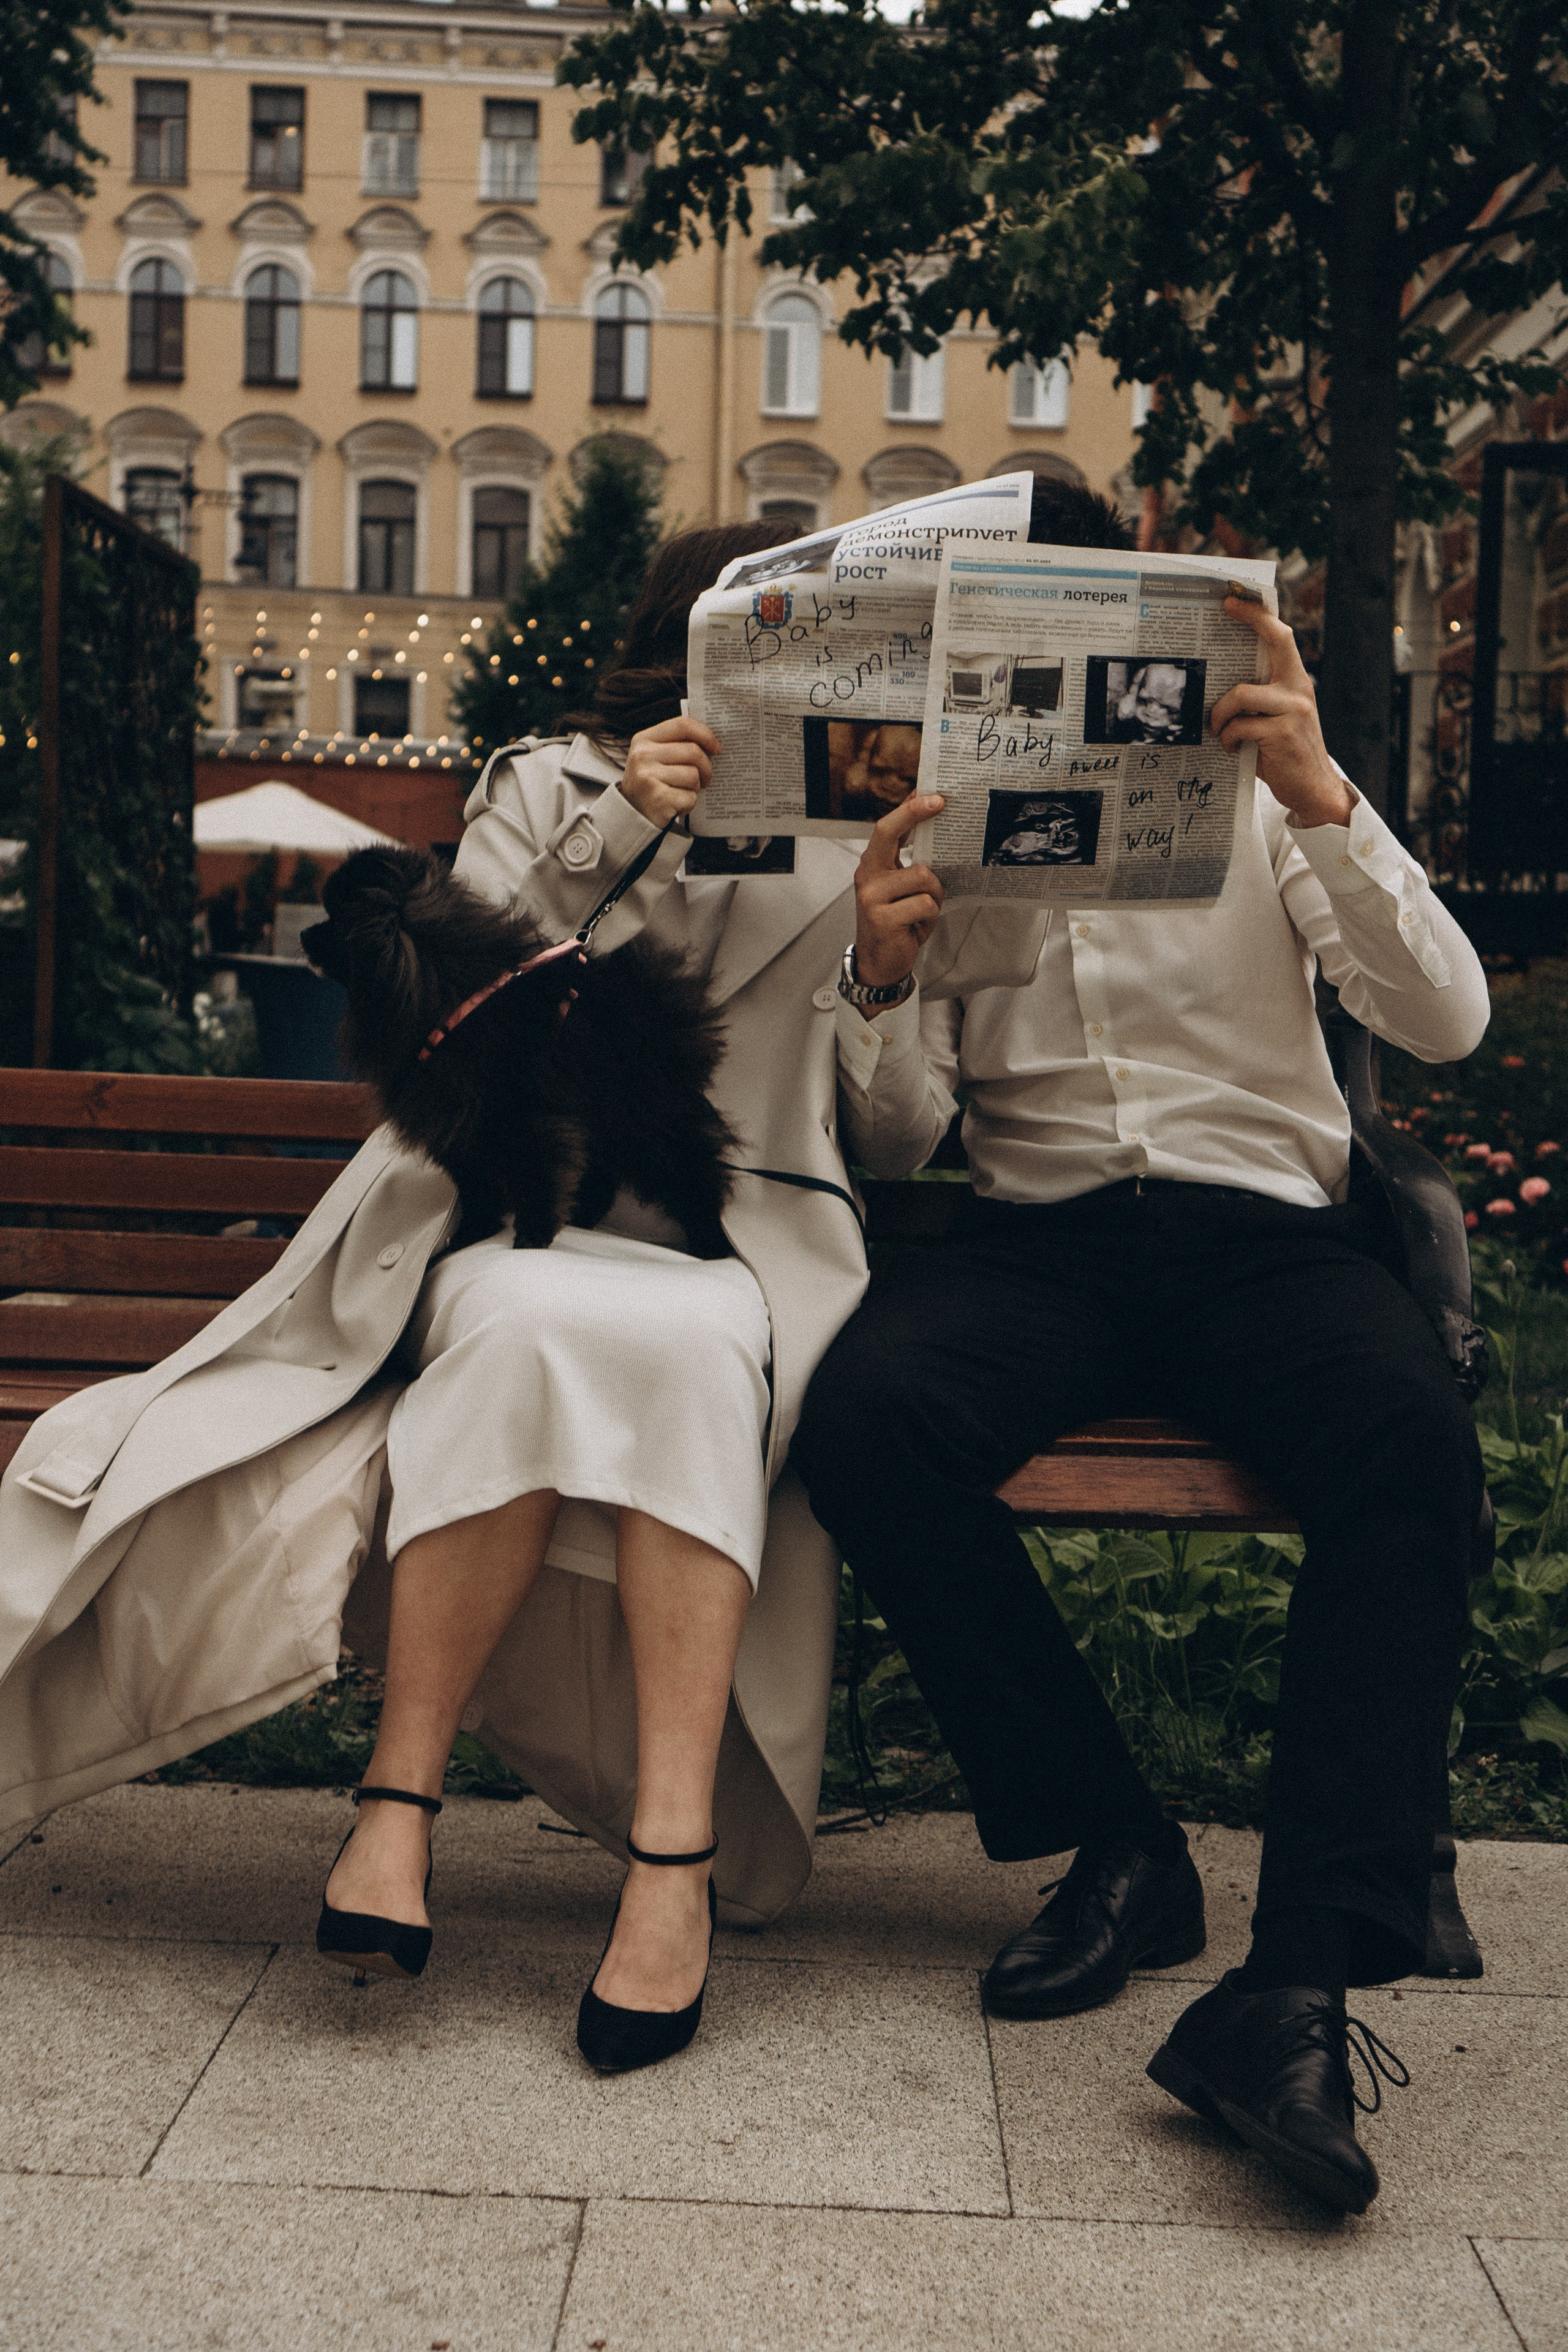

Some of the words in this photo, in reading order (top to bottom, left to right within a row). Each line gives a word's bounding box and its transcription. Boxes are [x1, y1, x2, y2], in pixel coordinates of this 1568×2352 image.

[848, 518, 907, 538] город
[835, 565, 888, 582] рост
[949, 582, 1058, 600] Генетическая
[1063, 589, 1128, 605] лотерея
[744, 592, 856, 671] Baby
[816, 646, 834, 666] is
[976, 715, 1054, 767] Baby
[1140, 753, 1161, 770] is
[1128, 789, 1153, 807] on
